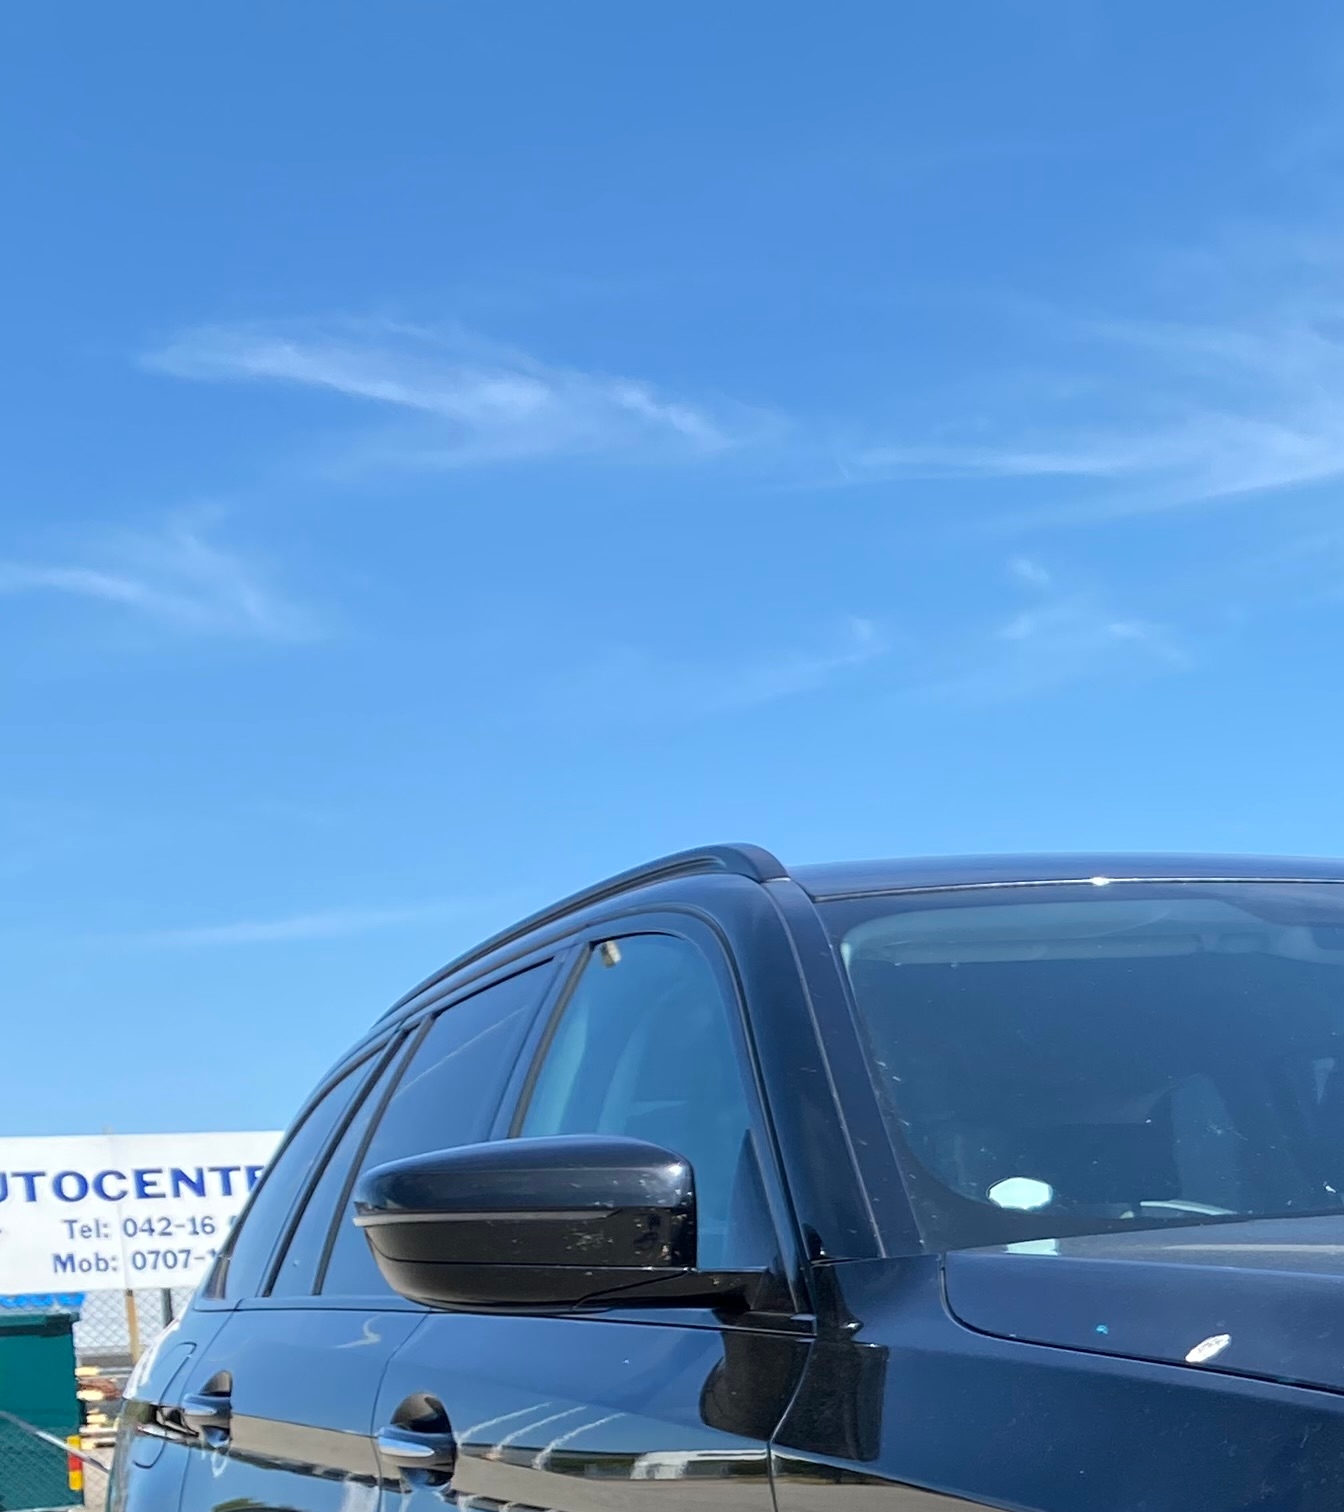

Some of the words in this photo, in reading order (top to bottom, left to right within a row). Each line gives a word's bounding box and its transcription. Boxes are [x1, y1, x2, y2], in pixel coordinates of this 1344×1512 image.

[0, 1165, 265, 1203] TOCENT
[63, 1218, 110, 1240] Tel:
[122, 1215, 216, 1238] 042-16
[53, 1252, 118, 1274] Mob:
[131, 1248, 219, 1271] 0707-
